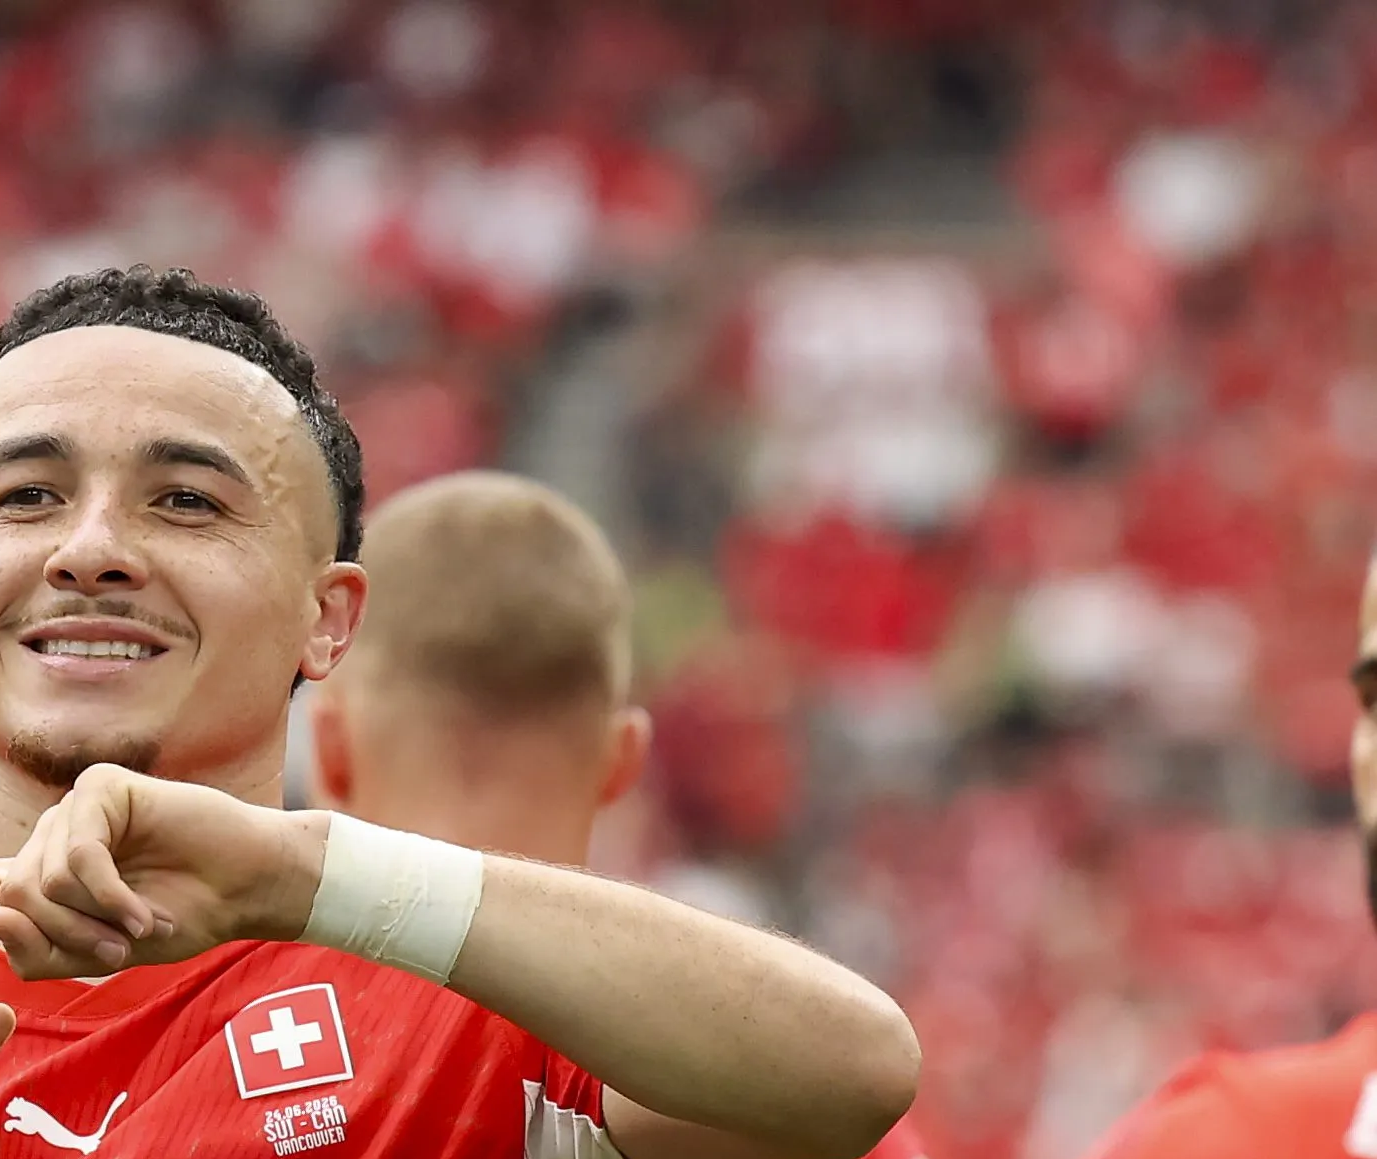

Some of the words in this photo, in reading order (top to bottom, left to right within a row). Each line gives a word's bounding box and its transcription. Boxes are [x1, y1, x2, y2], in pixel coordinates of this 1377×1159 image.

[263, 1118, 295, 1143] SUI
[310, 1104, 348, 1130] CAN
[265, 1095, 338, 1123] 24.06.2026
[273, 1126, 345, 1157] VANCOUVER
